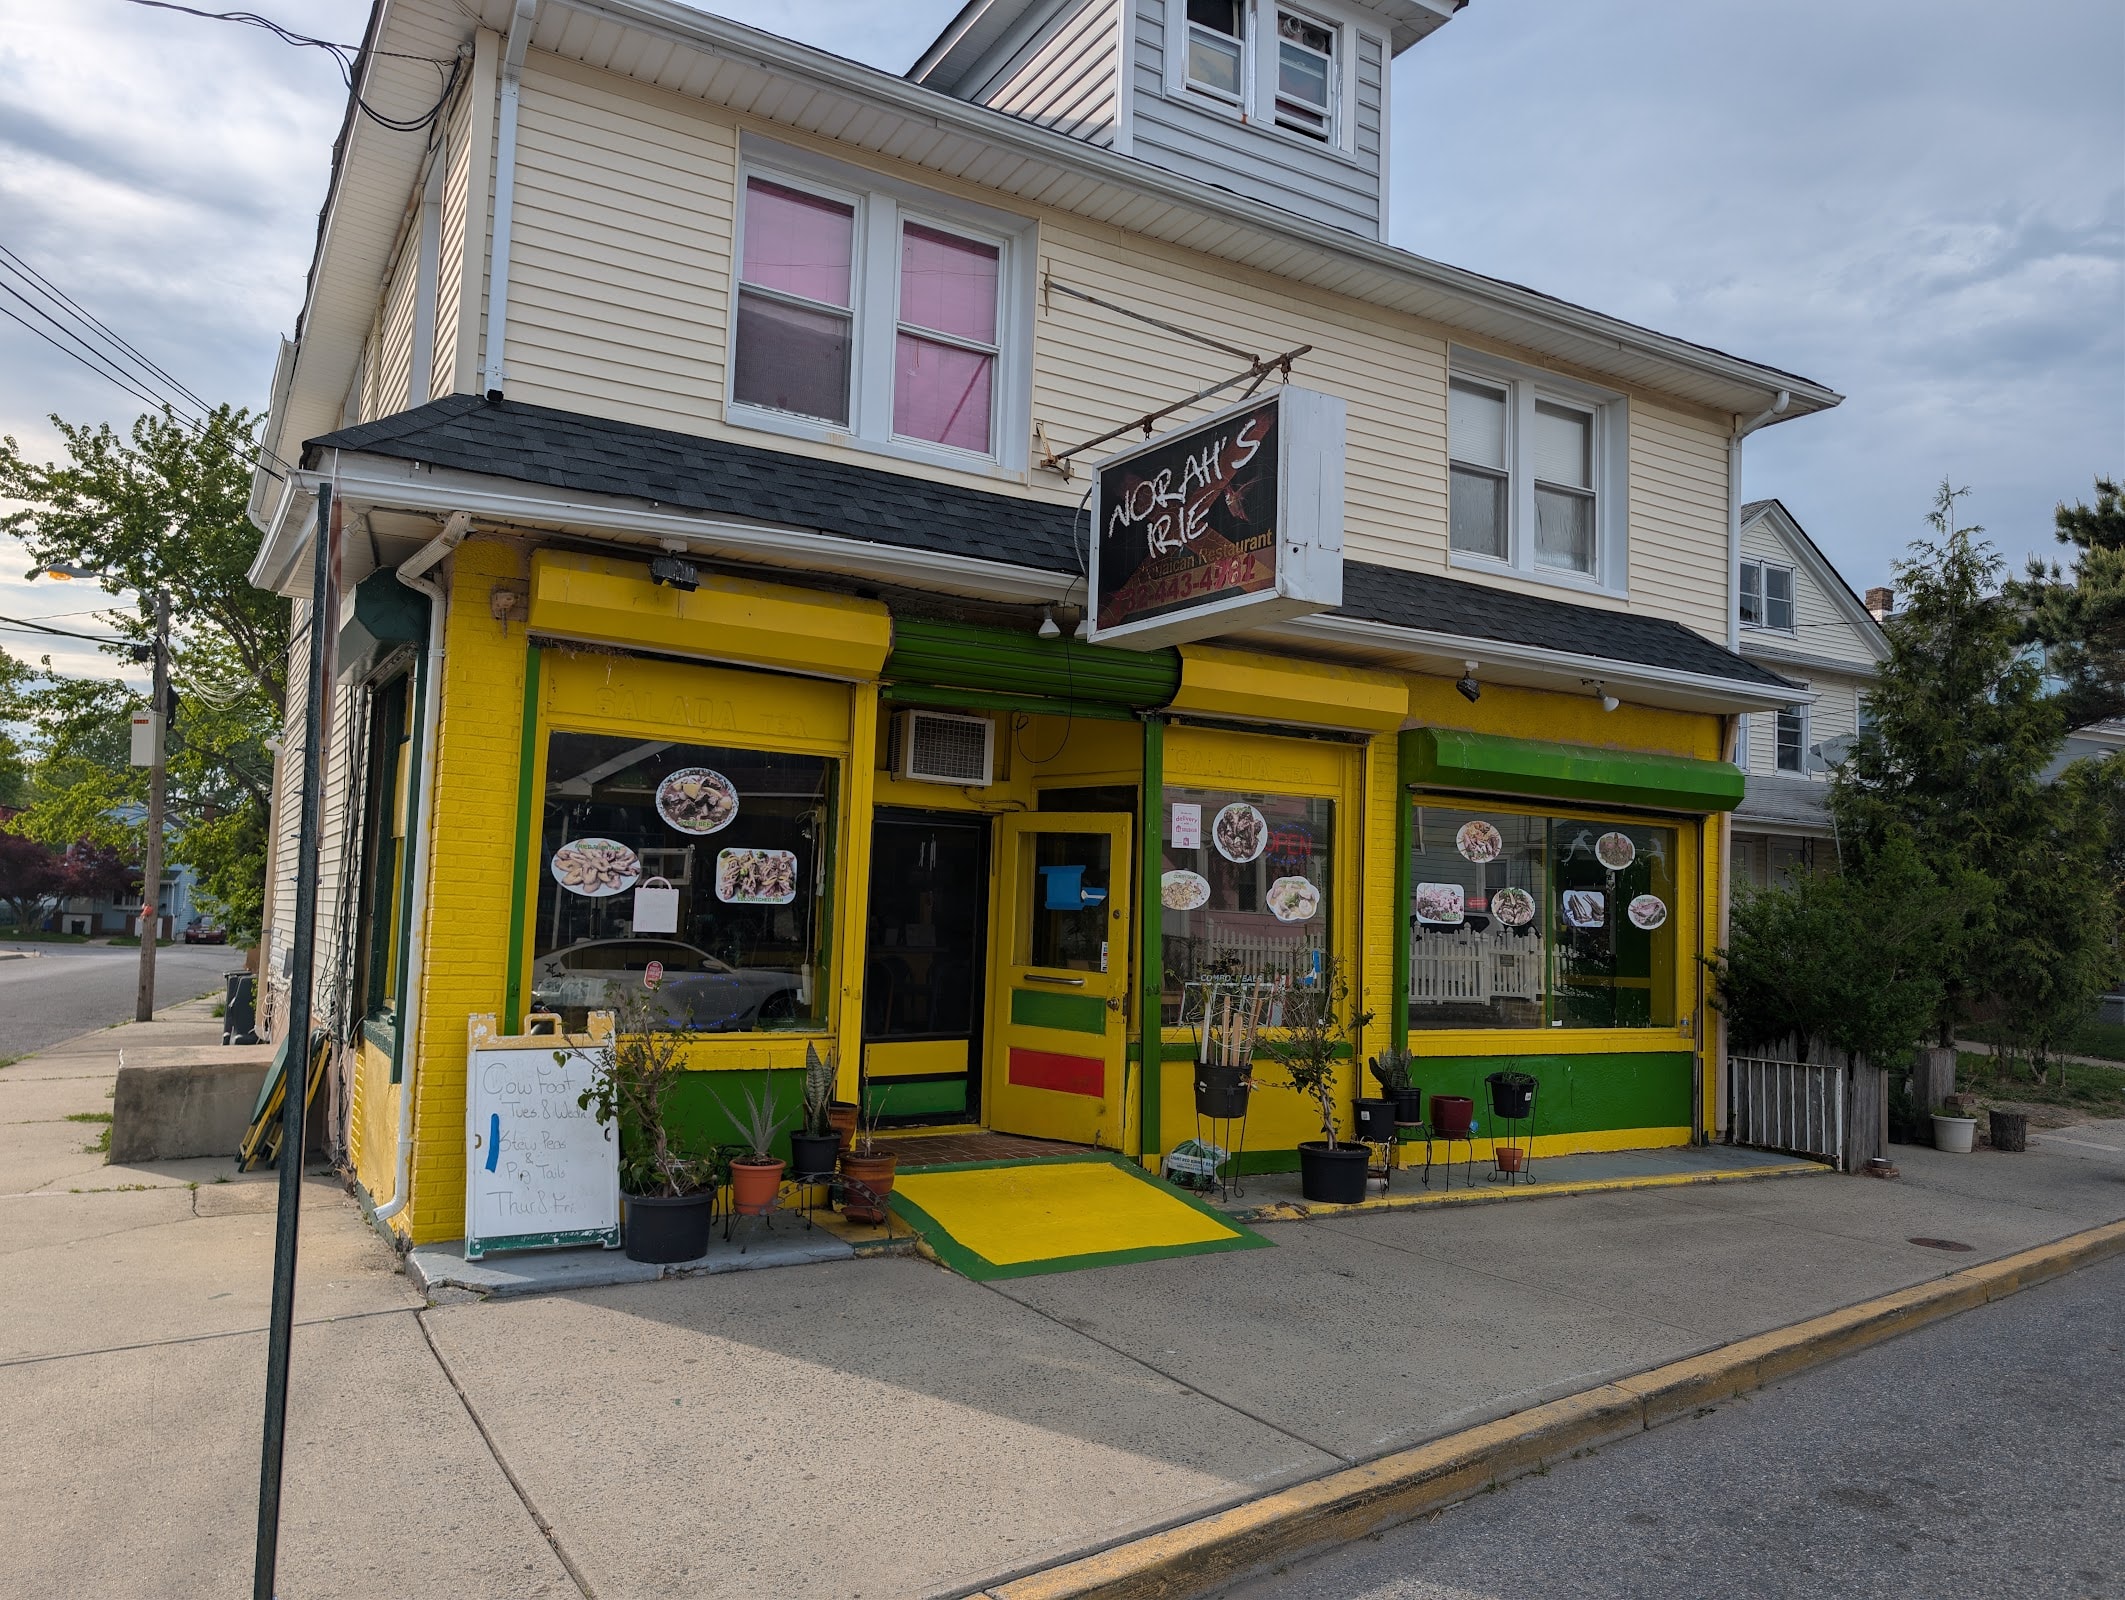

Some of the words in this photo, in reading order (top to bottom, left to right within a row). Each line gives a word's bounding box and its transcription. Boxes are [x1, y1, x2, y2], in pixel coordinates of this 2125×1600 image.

[1108, 418, 1260, 539] NORAH'S
[1147, 489, 1215, 559] IRIE
[1199, 528, 1273, 565] Restaurant
[483, 1062, 532, 1095] Cow
[536, 1065, 576, 1095] Foot
[499, 1129, 537, 1152] Stew
[541, 1130, 566, 1150] Peas
[506, 1161, 531, 1185] Pig
[535, 1162, 566, 1180] Tails
[525, 1152, 534, 1165] &
[486, 1191, 535, 1216] Thur
